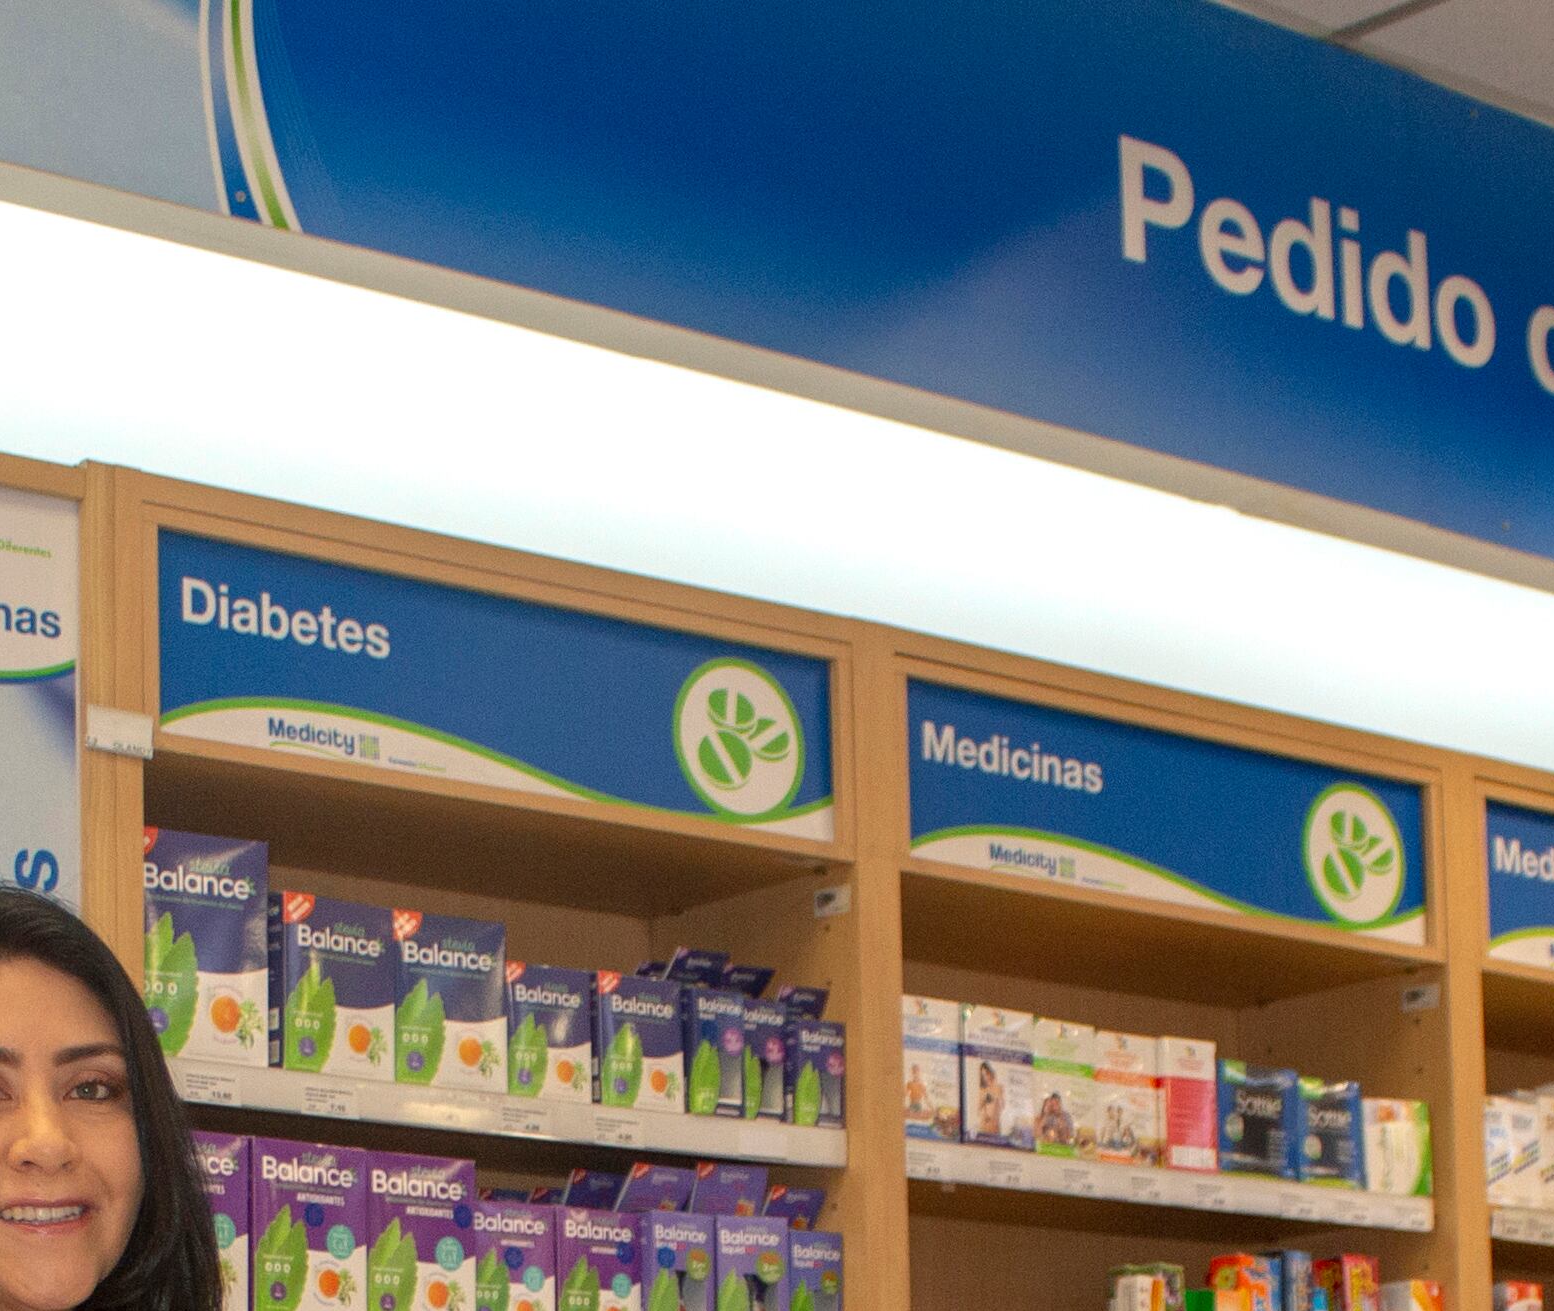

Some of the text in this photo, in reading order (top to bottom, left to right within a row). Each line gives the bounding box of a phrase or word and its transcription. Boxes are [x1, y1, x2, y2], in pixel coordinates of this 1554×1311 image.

[1117, 133, 1496, 368] Pedido
[182, 577, 390, 659] Diabetes
[268, 719, 354, 755] Medicity
[922, 723, 1103, 794] Medicinas
[989, 844, 1057, 876] Medicity
[144, 861, 250, 900] Balance
[298, 924, 382, 958] Balance
[403, 941, 493, 972] Balance
[516, 984, 581, 1009] Balance
[612, 995, 675, 1018] Balance
[261, 1155, 354, 1188] Balance
[371, 1170, 463, 1201] Balance
[474, 1211, 545, 1235] Balance
[565, 1219, 632, 1243] Balance
[721, 1229, 779, 1247] Balance
